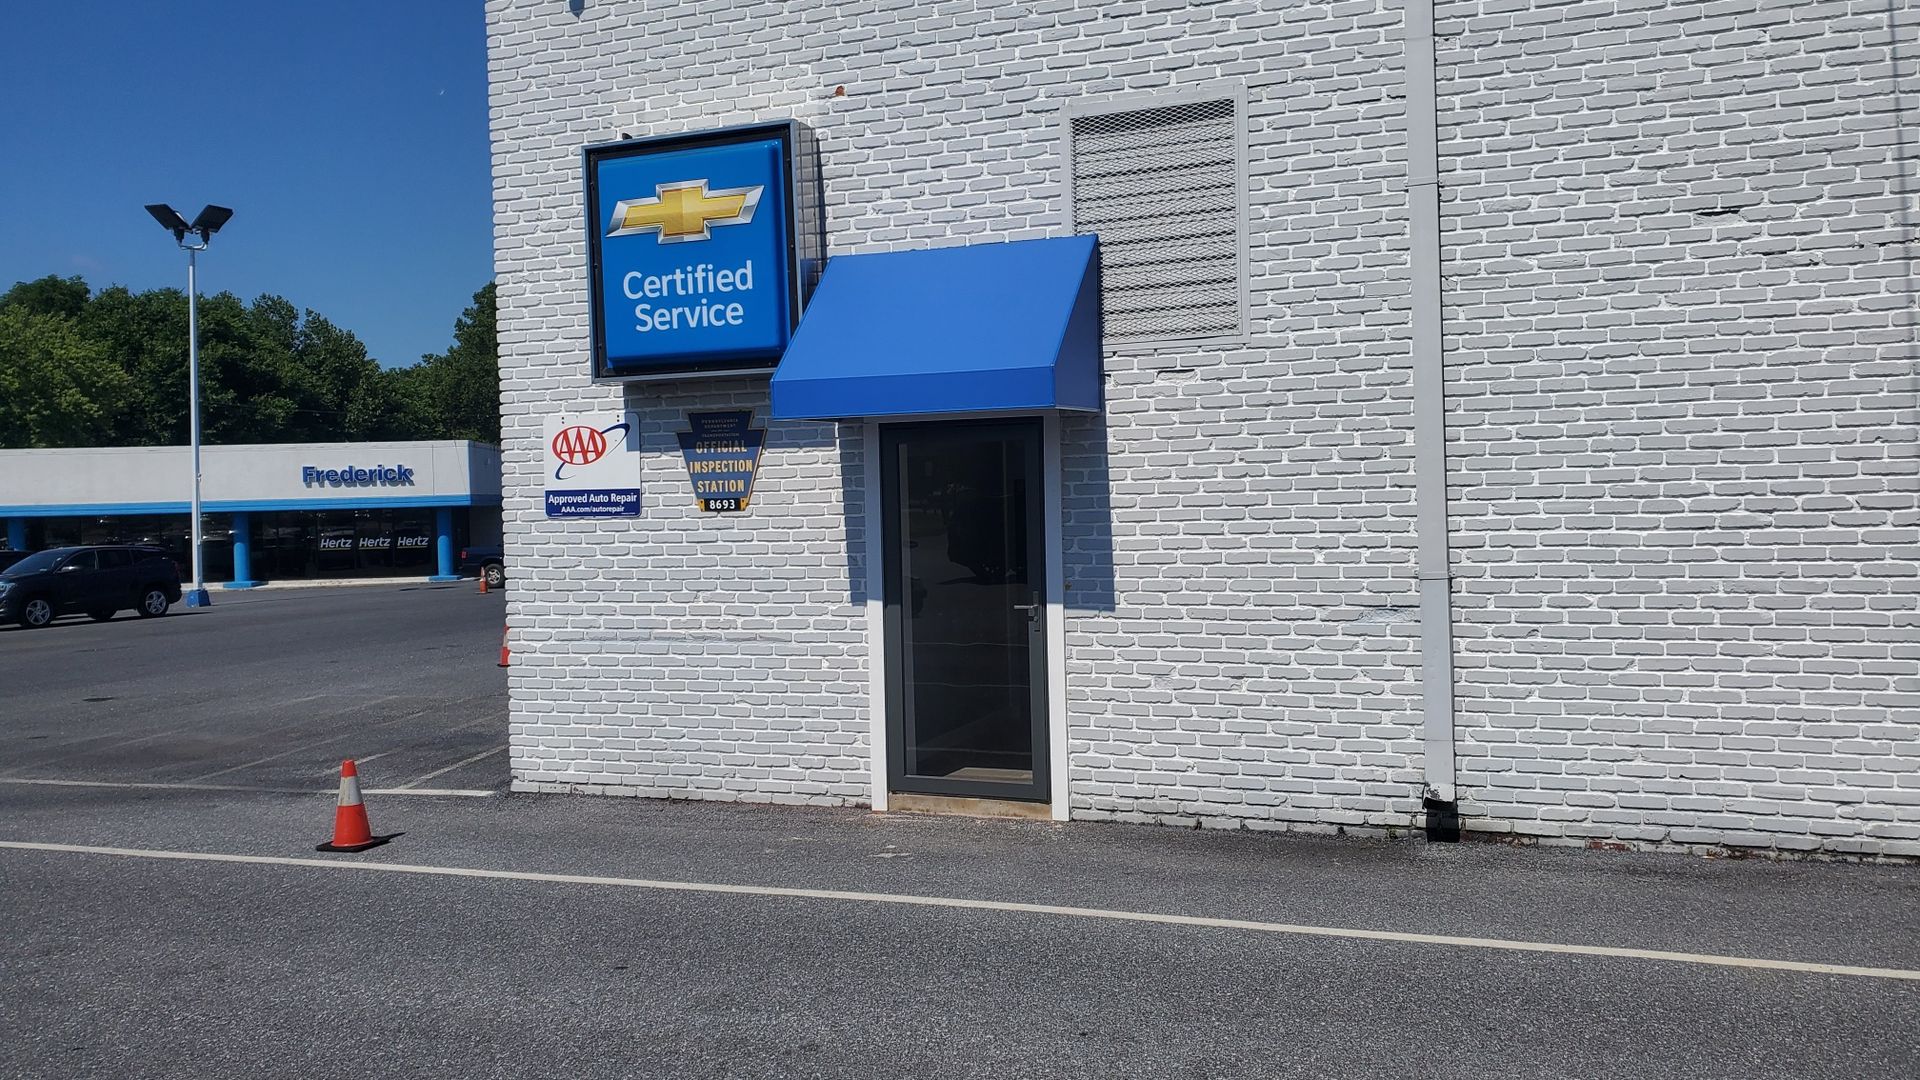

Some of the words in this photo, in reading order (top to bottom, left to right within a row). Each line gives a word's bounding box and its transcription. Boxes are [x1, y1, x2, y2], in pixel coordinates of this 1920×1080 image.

[623, 260, 753, 299] Certified
[635, 298, 744, 332] Service
[558, 427, 602, 464] AAA
[695, 440, 747, 454] OFFICIAL
[689, 460, 753, 473] INSPECTION
[302, 464, 414, 483] Frederick
[697, 480, 744, 493] STATION
[548, 493, 587, 505] Approved
[589, 494, 609, 503] Auto
[611, 492, 637, 504] Repair
[709, 499, 735, 510] 8693
[561, 504, 625, 513] AAA.com/autorepair
[320, 538, 352, 548] Hertz
[359, 537, 391, 547] Hertz
[397, 536, 429, 546] Hertz
